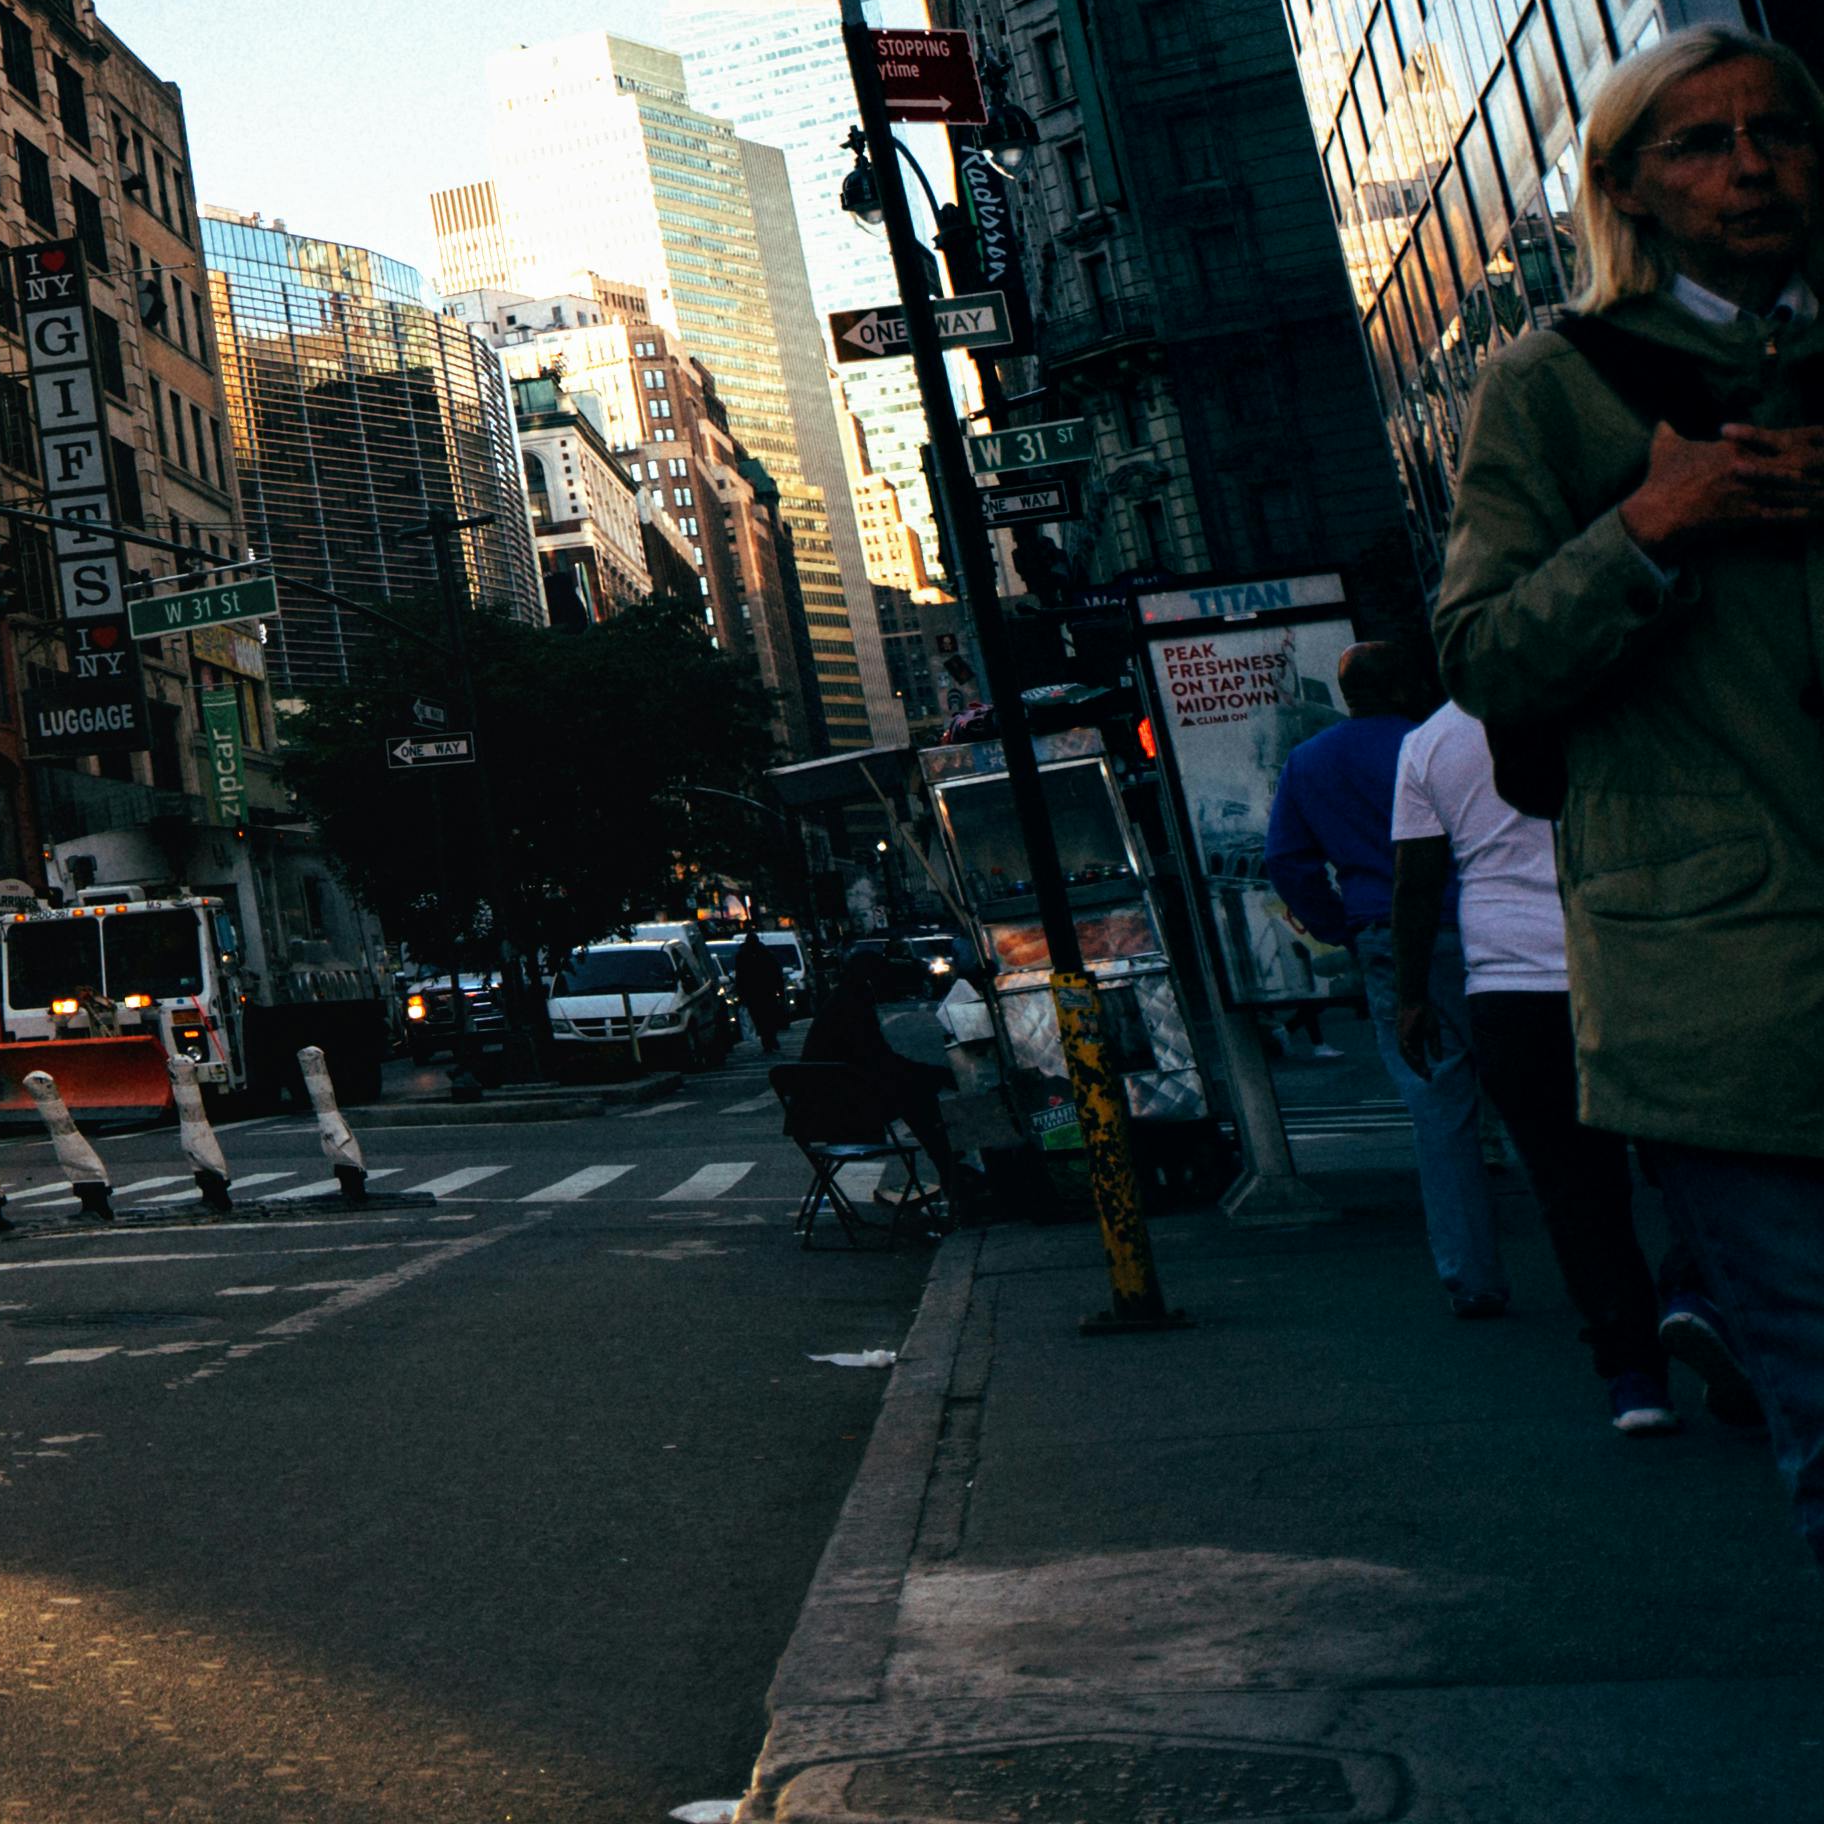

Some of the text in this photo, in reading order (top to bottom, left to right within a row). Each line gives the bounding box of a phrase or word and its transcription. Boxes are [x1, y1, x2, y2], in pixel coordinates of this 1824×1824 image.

[877, 39, 950, 57] STOPPING
[877, 60, 921, 81] ytime
[961, 145, 1008, 283] Radisson
[26, 254, 41, 276] I
[25, 274, 74, 301] NY
[859, 323, 907, 344] ONE
[978, 426, 1075, 468] W 31 ST
[35, 316, 111, 607] GIFTS
[982, 493, 1051, 514] ONE WAY
[164, 591, 241, 624] W 31 St
[1190, 581, 1292, 616] TITAN
[76, 628, 92, 651] I
[75, 651, 126, 678] NY
[1164, 643, 1217, 662] PEAK
[1167, 653, 1287, 679] FRESHNESS
[1171, 672, 1274, 696] ON TAP IN
[1176, 690, 1279, 715] MIDTOWN
[38, 703, 135, 737] LUGGAGE
[1196, 713, 1248, 725] CLIMB ON
[400, 741, 460, 758] ONE WAY
[212, 727, 245, 818] zipcar
